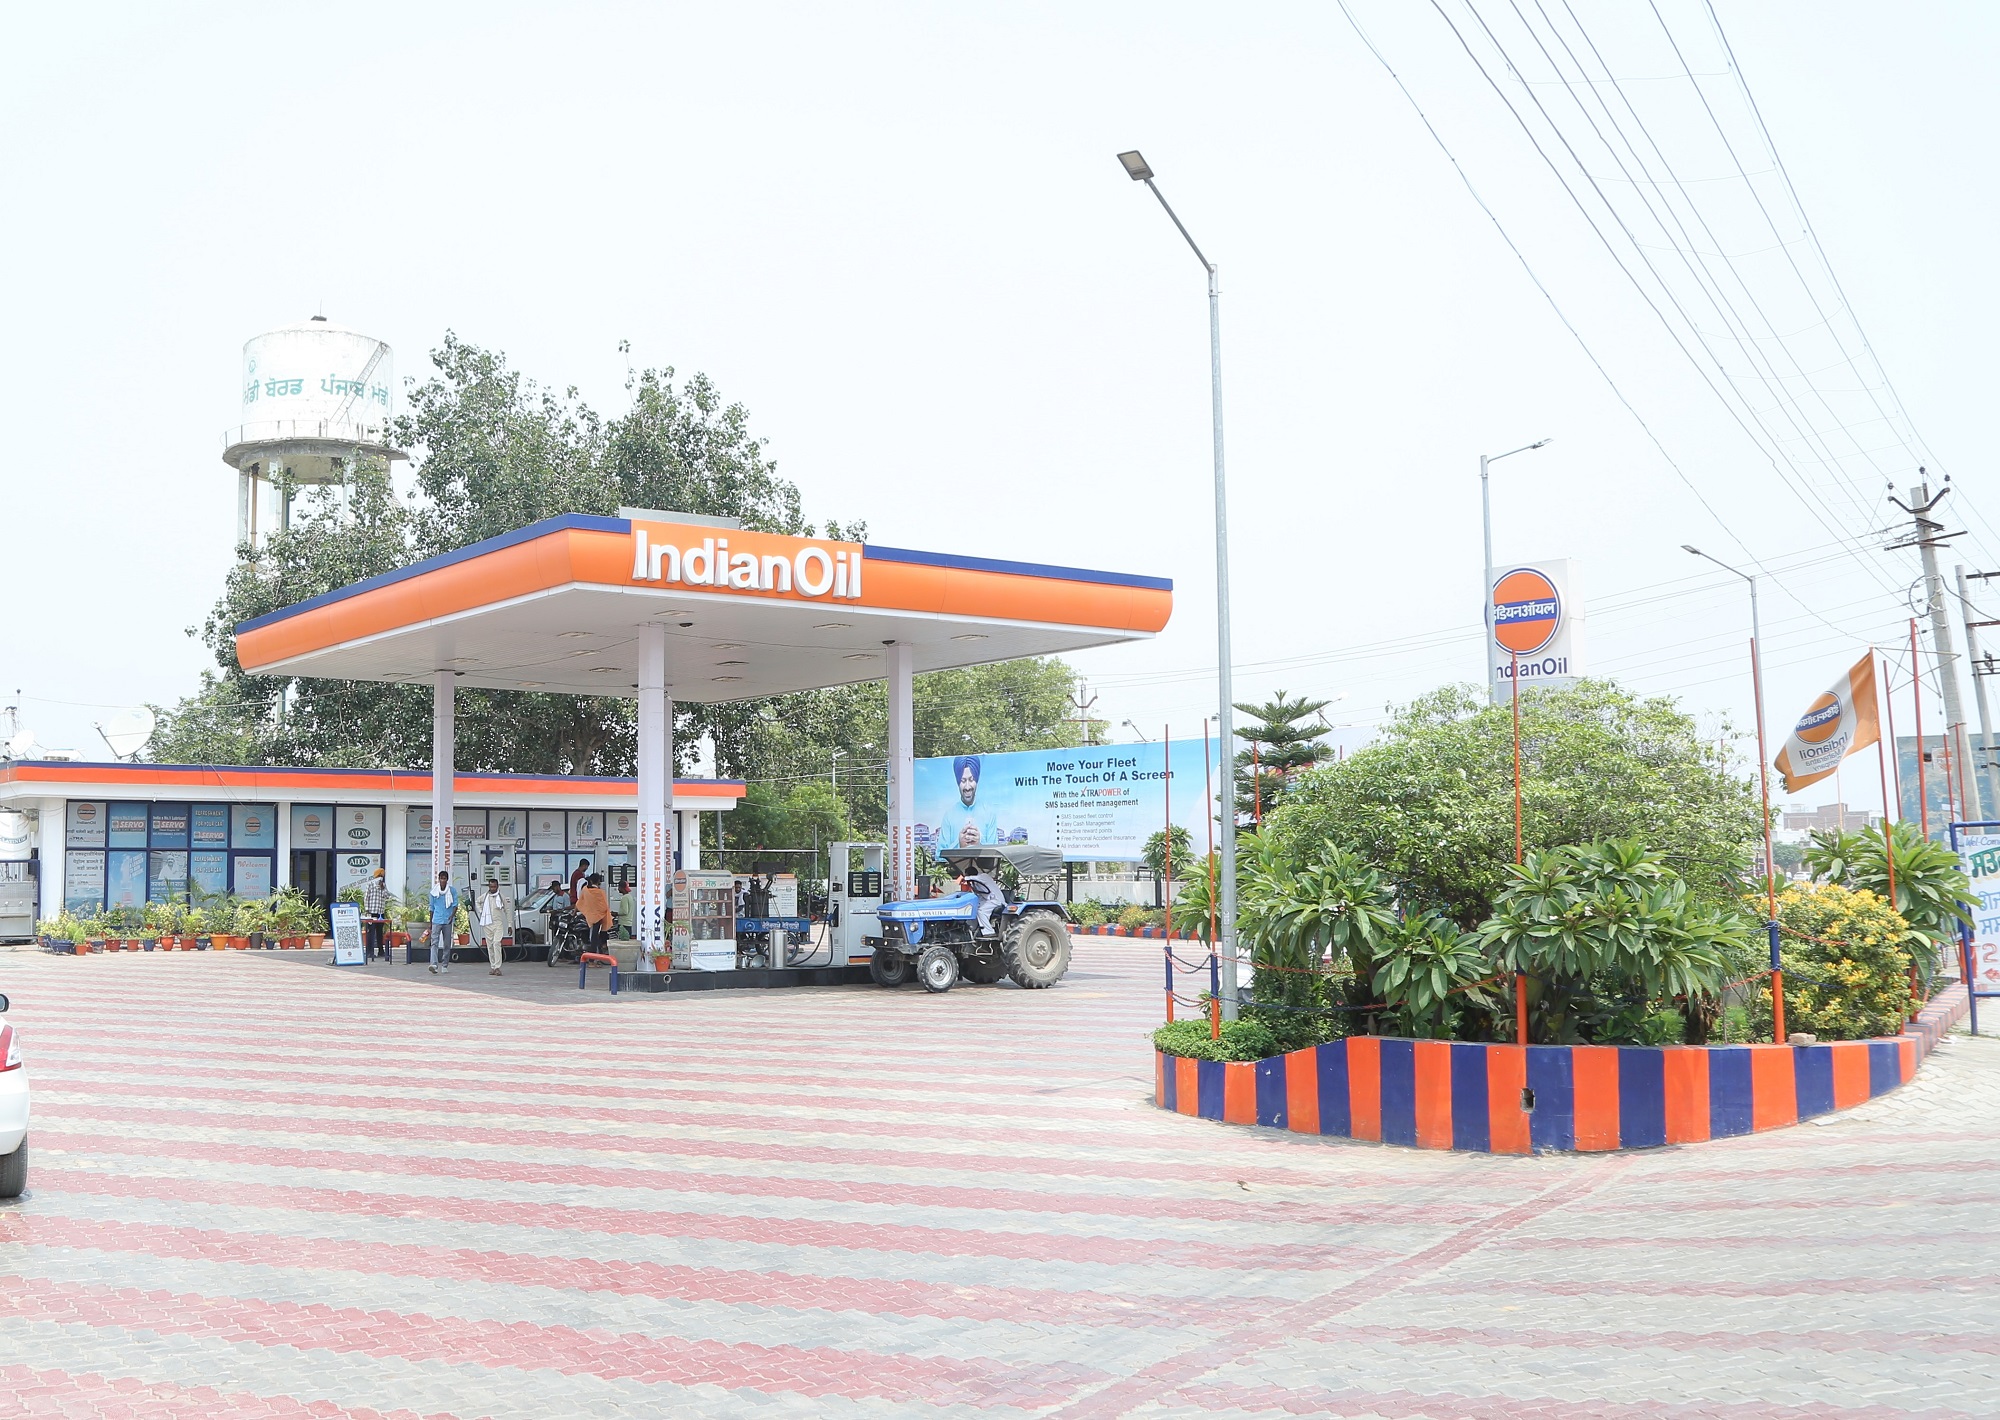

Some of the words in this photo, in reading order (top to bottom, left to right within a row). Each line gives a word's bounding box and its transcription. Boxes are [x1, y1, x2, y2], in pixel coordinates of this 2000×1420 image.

[265, 376, 304, 397] ਬੋਰਡ
[632, 530, 861, 599] IndianOil
[1496, 657, 1568, 679] ndianOil
[1046, 762, 1074, 772] Move
[1078, 760, 1104, 770] Your
[1108, 757, 1136, 768] Fleet
[1014, 776, 1038, 787] With
[1042, 775, 1062, 785] The
[1065, 772, 1099, 784] Touch
[1102, 771, 1116, 782] Of
[1119, 772, 1128, 782] A
[1132, 770, 1174, 781] Screen
[1052, 790, 1068, 798] With
[1068, 790, 1078, 798] the
[1080, 786, 1122, 797] XTRAPOWER
[1122, 788, 1130, 796] of
[1045, 801, 1058, 809] SMS
[1060, 800, 1078, 808] based
[1080, 800, 1095, 808] fleet
[1096, 798, 1138, 808] management
[458, 826, 484, 834] SERVO
